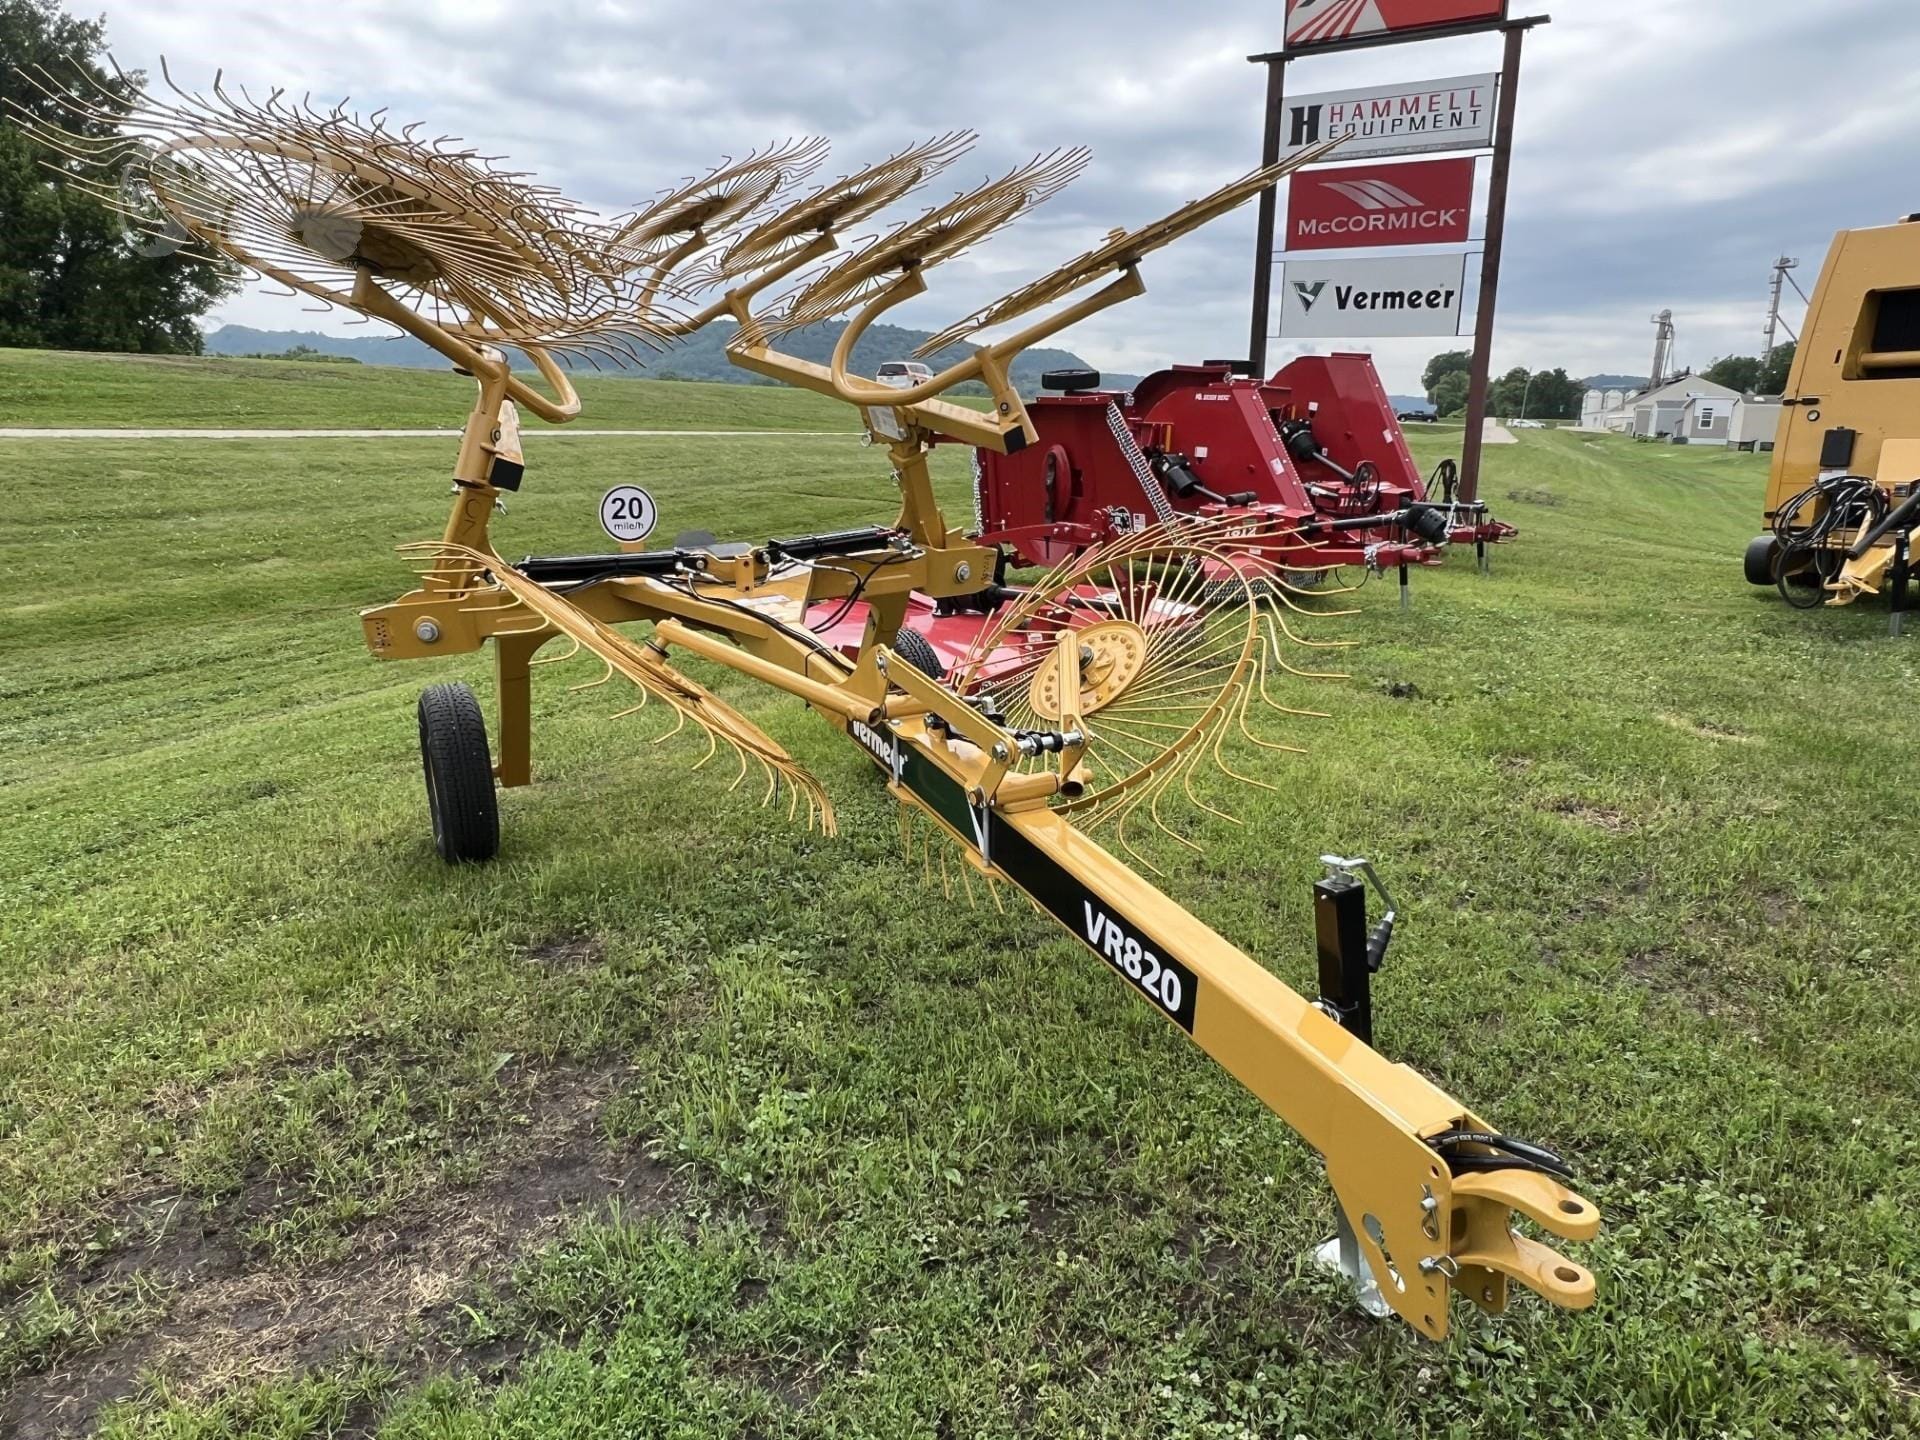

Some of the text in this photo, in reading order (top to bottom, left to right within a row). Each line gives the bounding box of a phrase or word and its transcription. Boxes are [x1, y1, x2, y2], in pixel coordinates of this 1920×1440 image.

[1329, 89, 1482, 123] HAMMELL
[1328, 109, 1482, 139] EQUIPMENT
[1298, 208, 1457, 236] McCORMICK
[1335, 285, 1455, 310] Vermeer
[611, 497, 643, 520] 20
[614, 521, 644, 530] mile/h
[852, 720, 905, 776] Vermer
[1083, 900, 1182, 1013] VR820
